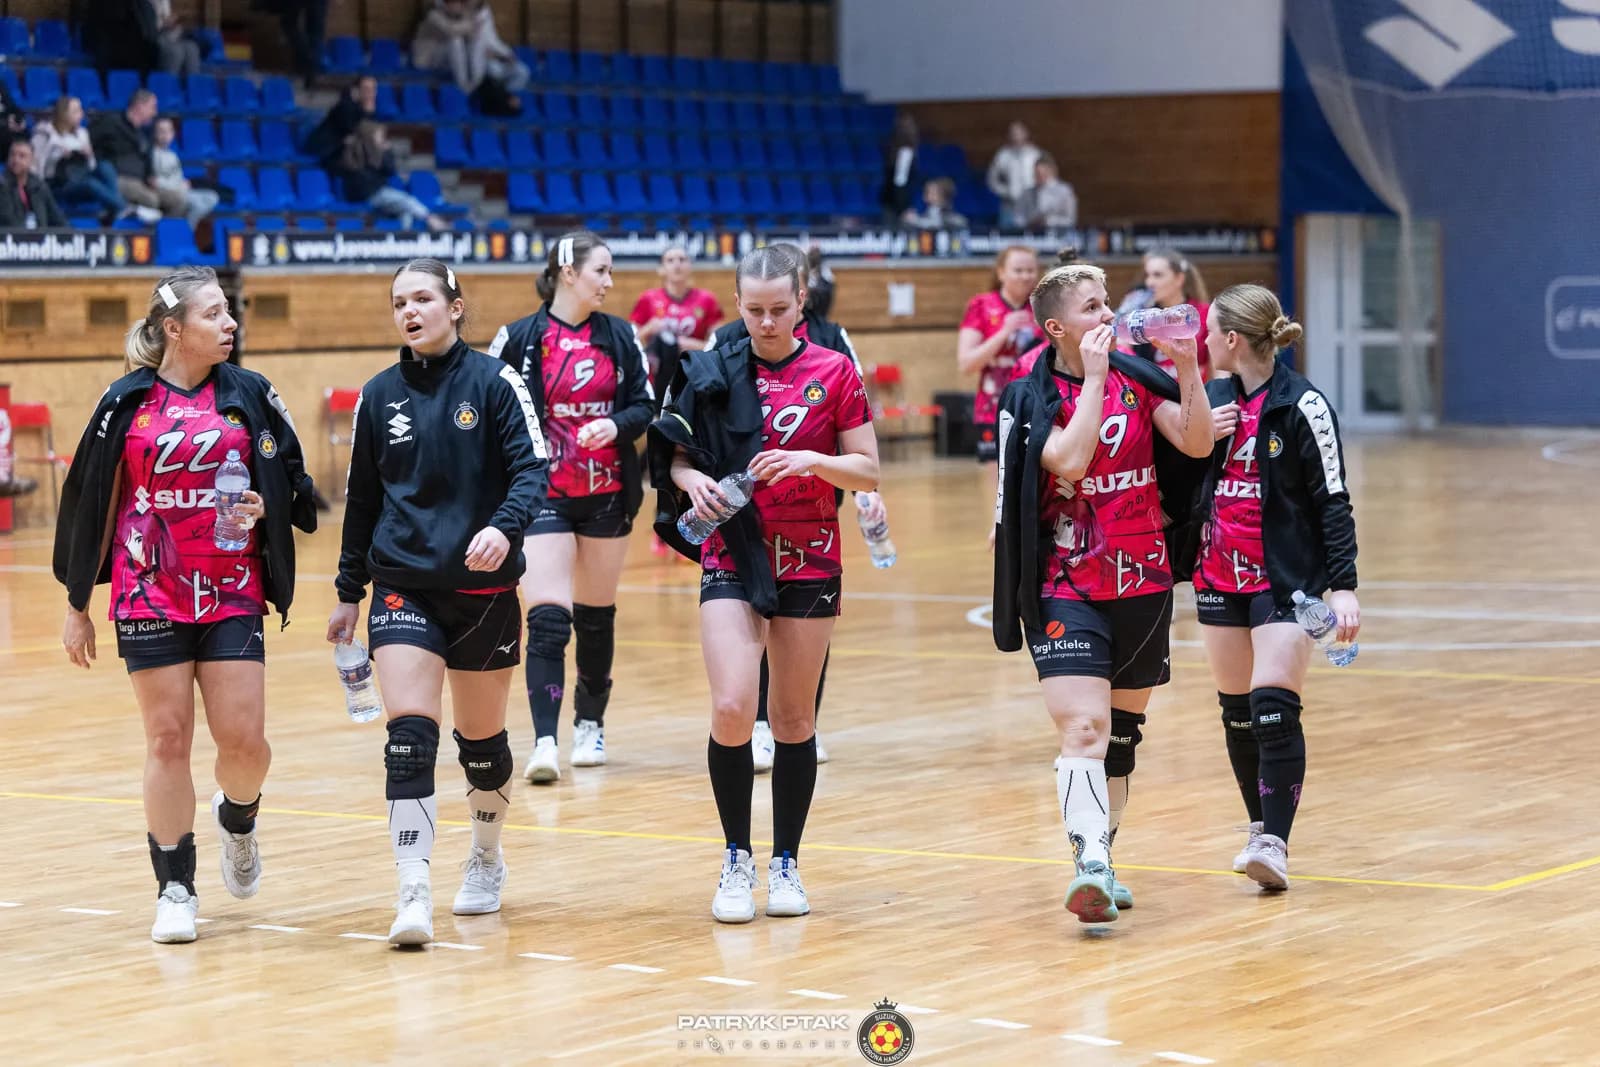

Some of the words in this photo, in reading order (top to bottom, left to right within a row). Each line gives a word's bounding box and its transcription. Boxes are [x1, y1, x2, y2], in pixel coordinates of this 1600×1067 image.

[571, 358, 595, 393] 5
[389, 435, 413, 445] SUZUKI
[153, 429, 221, 475] 22
[370, 611, 389, 625] Targi
[392, 611, 427, 625] Kielce
[117, 621, 136, 635] Targi
[138, 619, 173, 632] Kielce
[1032, 641, 1052, 655] Targi
[1054, 639, 1091, 650] Kielce
[1259, 712, 1281, 722] SELECT
[1230, 720, 1253, 728] SELECT
[390, 745, 411, 753] SELECT
[468, 761, 492, 769] SELECT
